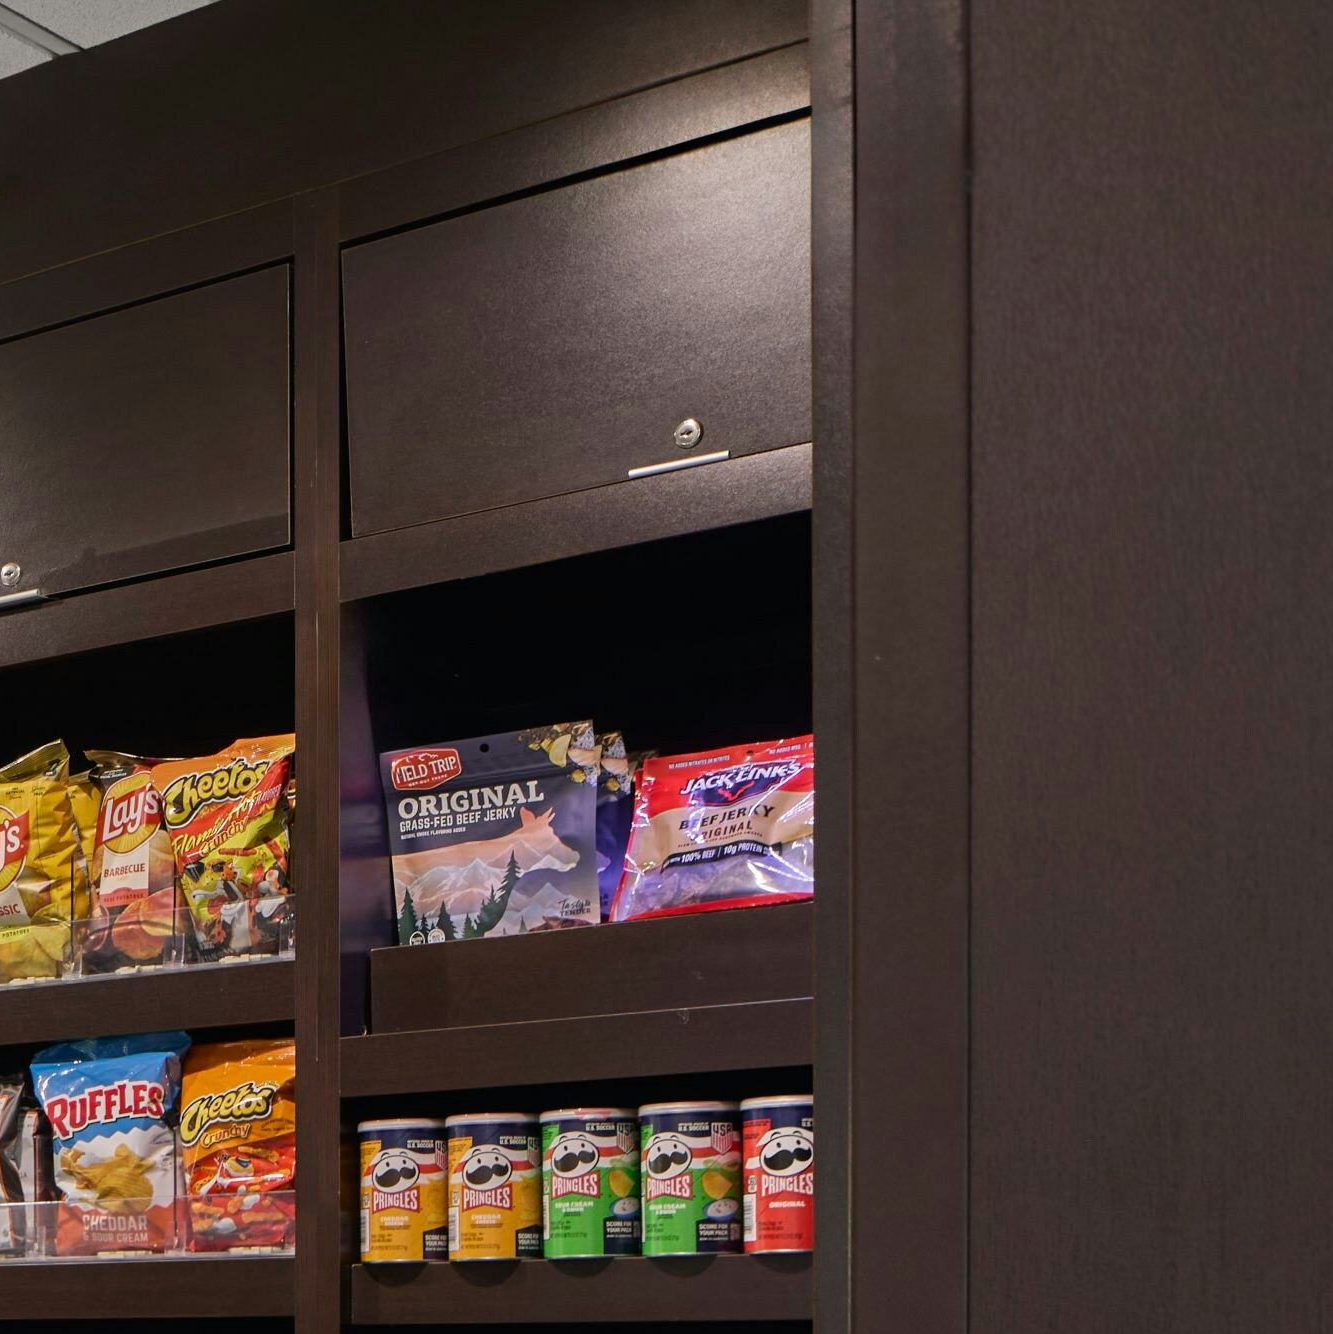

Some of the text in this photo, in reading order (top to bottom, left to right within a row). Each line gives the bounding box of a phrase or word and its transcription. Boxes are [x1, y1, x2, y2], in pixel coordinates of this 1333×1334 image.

[429, 755, 457, 775] TRIP
[165, 761, 270, 825] Cheetos
[398, 780, 545, 820] ORIGINAL
[102, 783, 160, 842] Lay's
[399, 806, 517, 833] GRASS-FED BEEF JERKY
[103, 863, 146, 878] BARBECUE
[46, 1082, 164, 1138] RUFFLES
[182, 1084, 271, 1143] Cheetos
[552, 1173, 599, 1197] PRINGLES
[646, 1175, 691, 1200] PRINGLES
[761, 1173, 813, 1197] PRINGLES
[373, 1189, 419, 1212] PRINGLES
[463, 1186, 511, 1211] PRINGLES
[768, 1200, 806, 1209] ORIGINAL
[82, 1214, 148, 1232] CHEDDAR
[91, 1231, 149, 1243] SOUR CREAM
